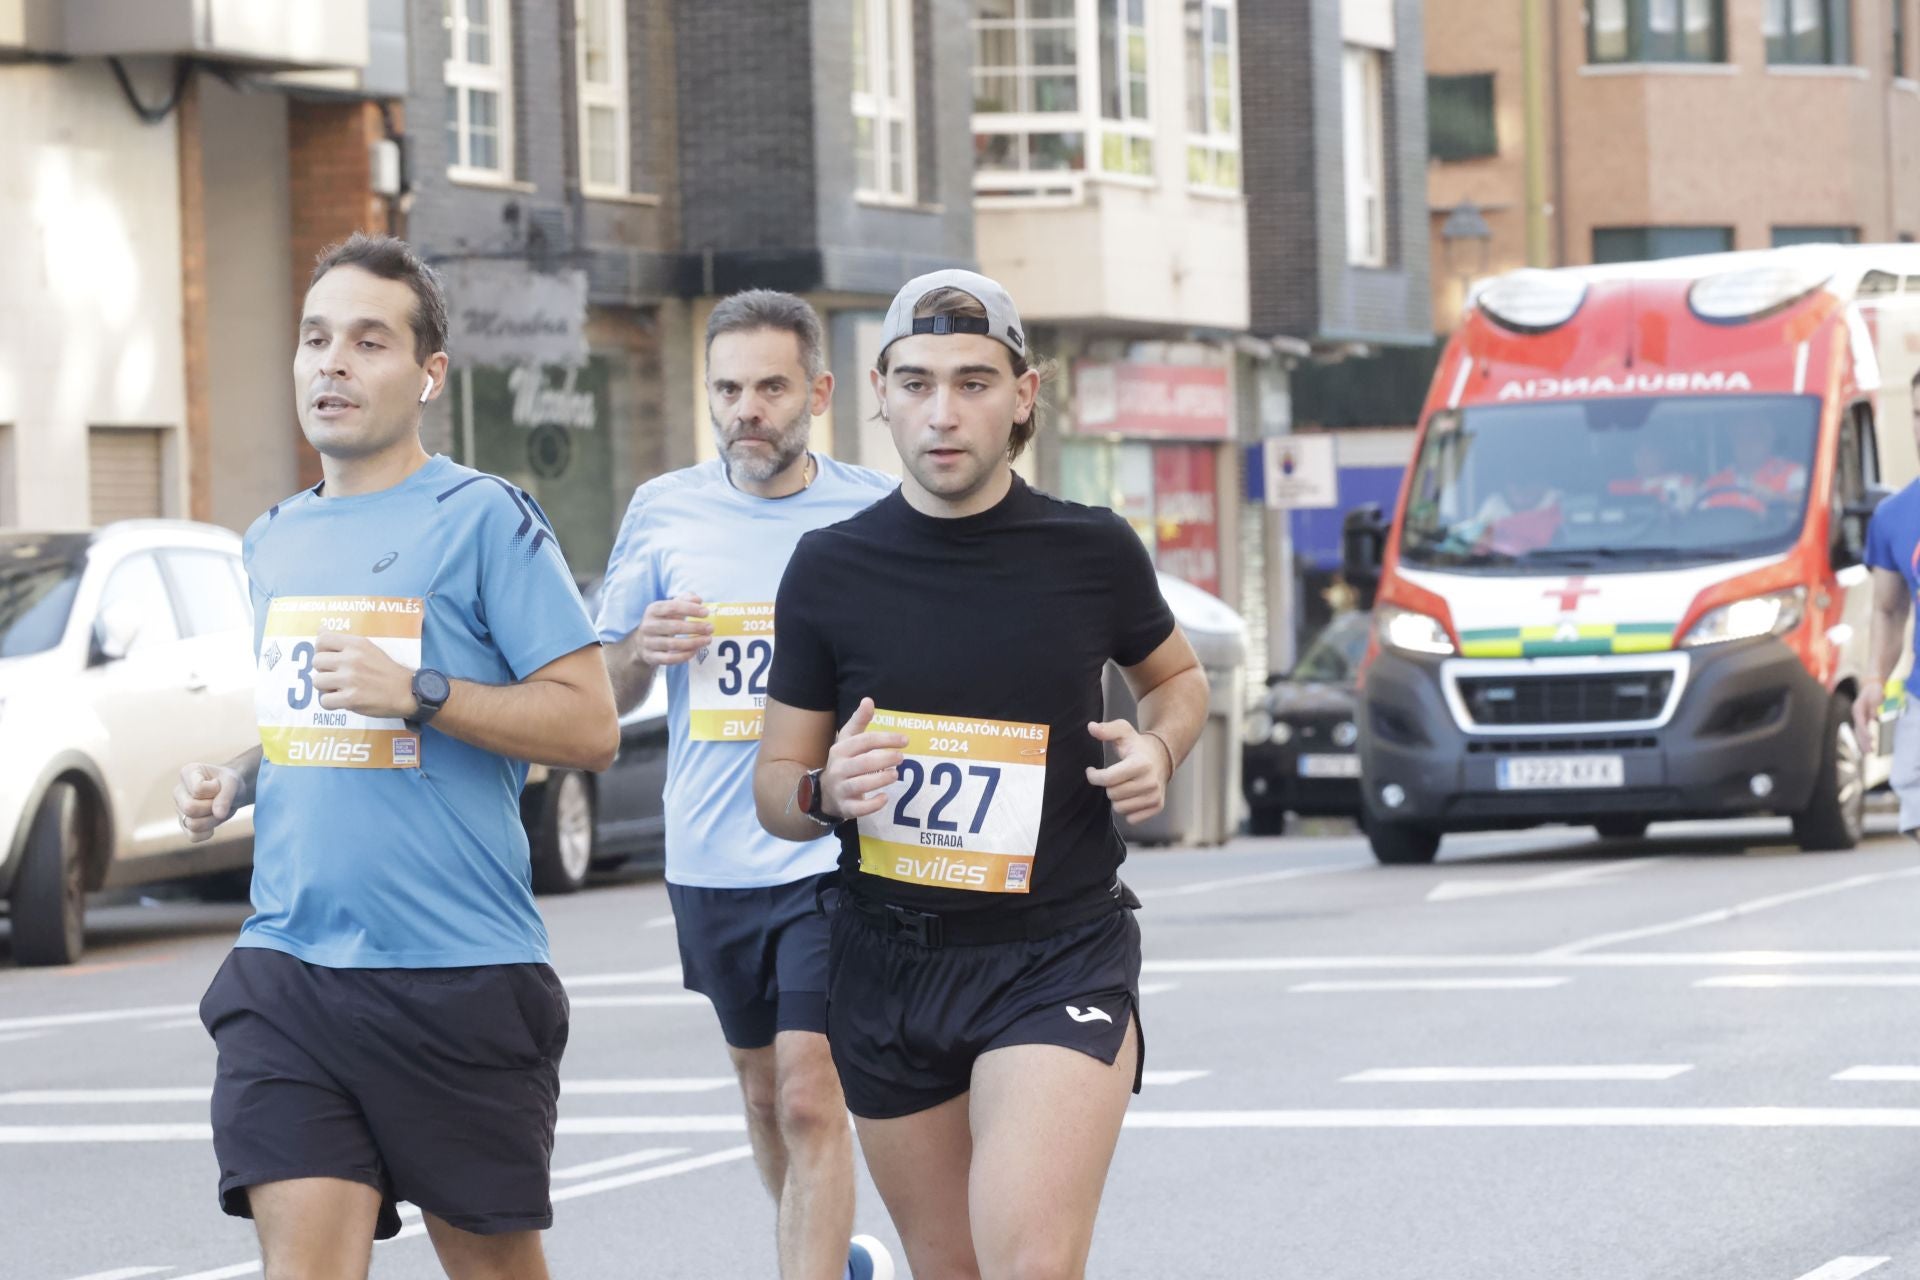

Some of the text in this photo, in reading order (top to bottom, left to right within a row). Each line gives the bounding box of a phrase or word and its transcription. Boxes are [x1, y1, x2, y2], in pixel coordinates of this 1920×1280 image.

[328, 598, 375, 612] MARATÓN
[377, 599, 420, 614] AVILÉS
[717, 606, 744, 617] MEDIA
[747, 606, 775, 616] MARA
[287, 640, 318, 710] 3
[717, 639, 772, 696] 32
[313, 712, 347, 727] PANCHO
[723, 716, 765, 737] avi
[897, 717, 934, 731] MEDIA
[937, 721, 1000, 737] MARATÓN
[1001, 725, 1044, 741] AVILÉS
[288, 737, 372, 762] avilés
[928, 738, 969, 753] 2024
[893, 757, 1002, 835] 227
[920, 832, 963, 849] ESTRADA
[895, 856, 988, 885] avilés
